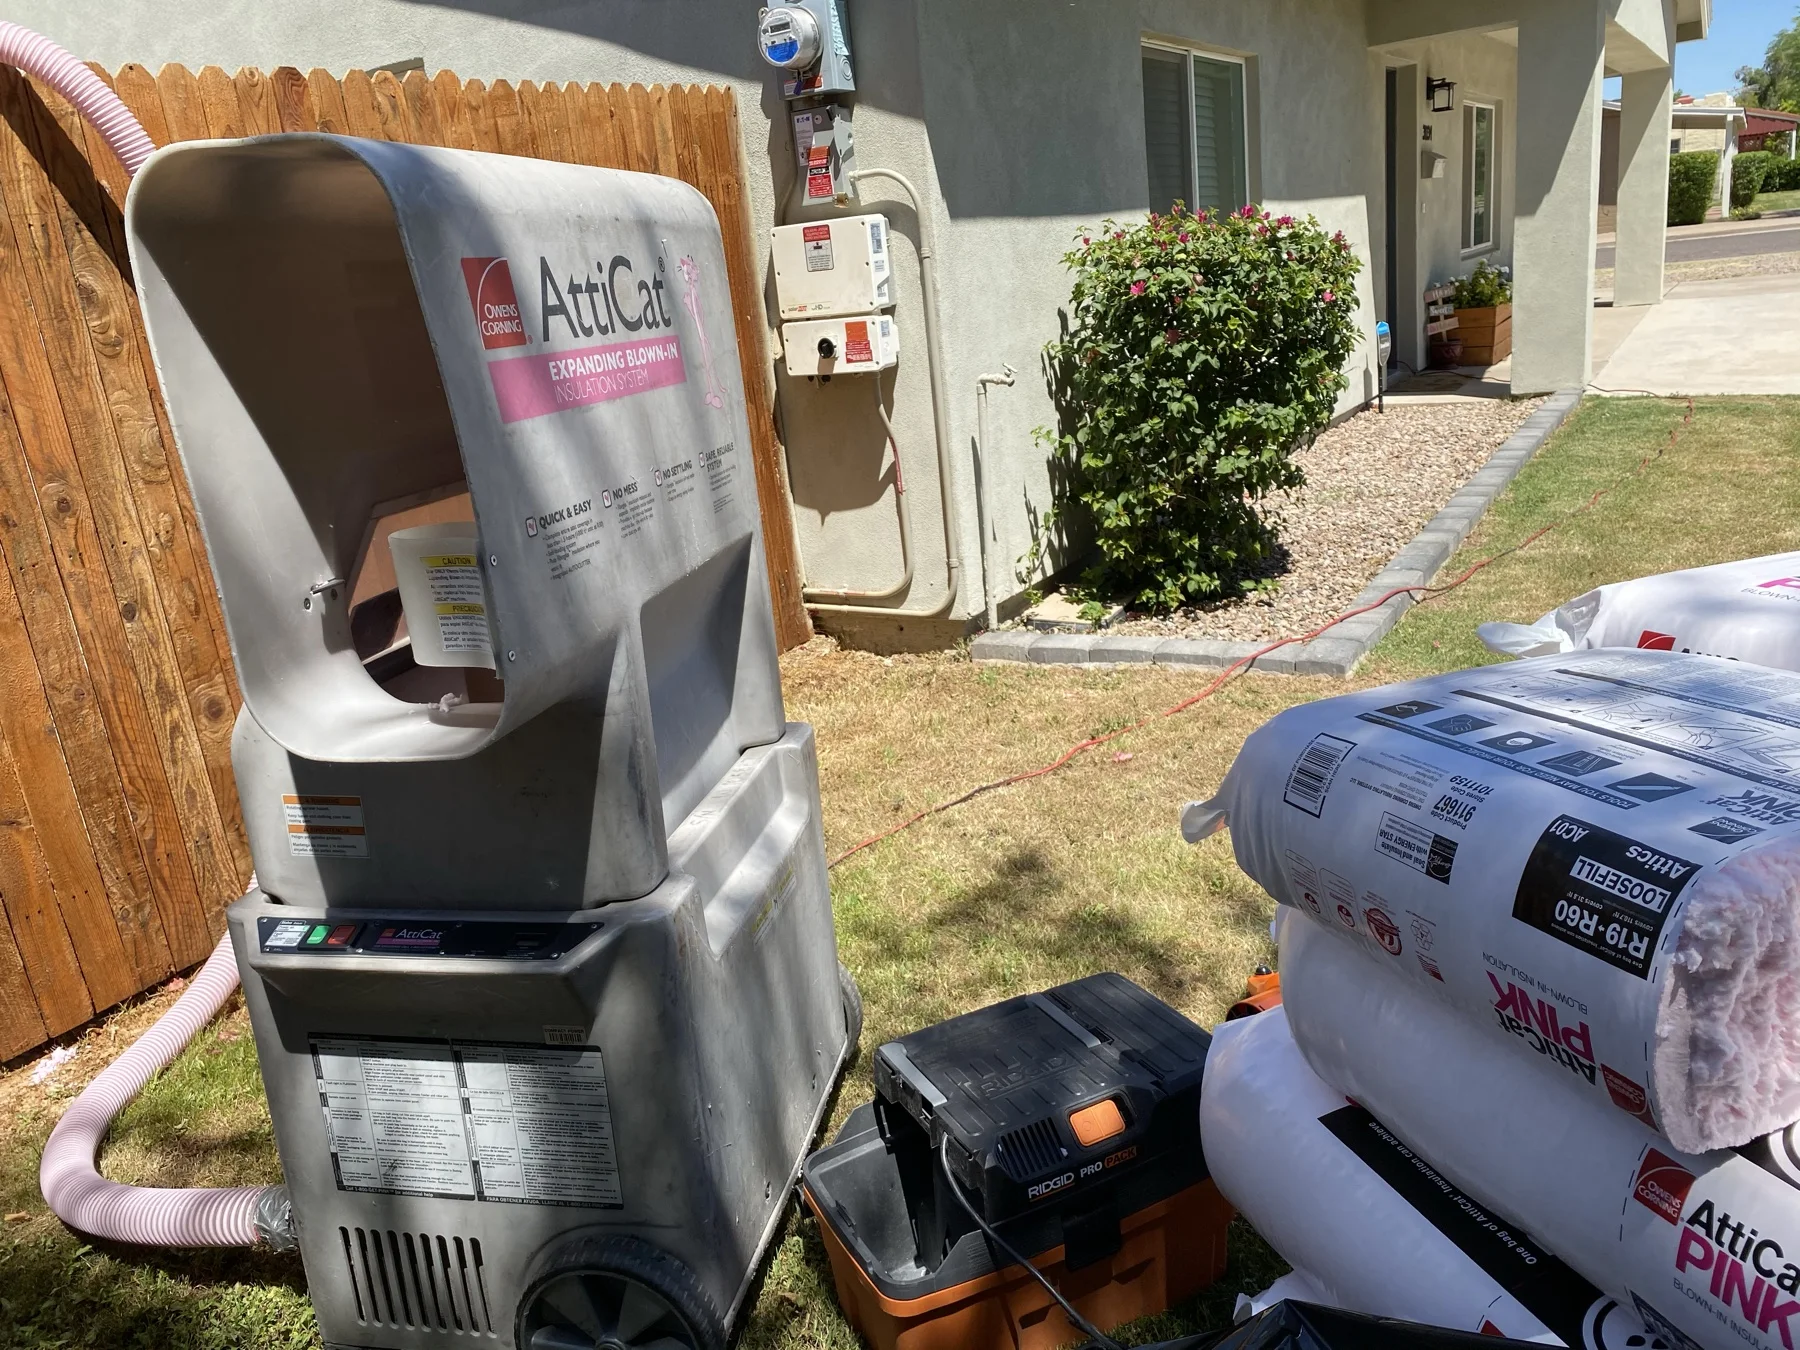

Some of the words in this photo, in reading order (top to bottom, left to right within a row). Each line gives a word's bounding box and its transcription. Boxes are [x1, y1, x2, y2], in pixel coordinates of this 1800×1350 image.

[484, 303, 518, 319] OWENS
[481, 320, 522, 336] CORNING
[548, 349, 624, 381] EXPANDING
[626, 343, 679, 366] BLOWN-IN
[553, 376, 618, 404] INSULATION
[617, 368, 649, 394] SYSTEM
[707, 458, 723, 472] SYSTEM
[662, 469, 671, 480] NO
[612, 487, 623, 501] NO
[623, 482, 638, 496] MESS
[539, 508, 566, 530] QUICK
[567, 508, 573, 518] &
[573, 499, 592, 517] EASY
[442, 557, 471, 565] CAUTION
[1450, 775, 1494, 796] 1011159
[1450, 785, 1466, 797] Code
[1557, 776, 1579, 791] MAY
[1578, 785, 1599, 798] YOU
[1466, 791, 1486, 803] Stores
[1599, 792, 1632, 807] TOOLS
[1430, 810, 1445, 821] Code
[1434, 794, 1477, 823] 911667
[1445, 815, 1467, 830] Product
[1549, 820, 1590, 843] AC01
[1379, 829, 1394, 844] STAR
[1393, 836, 1416, 853] ENERGY
[1381, 841, 1402, 858] Insulate
[1402, 851, 1413, 862] and
[1416, 845, 1428, 856] with
[1413, 857, 1426, 869] Seal
[1625, 845, 1691, 879] Attics
[1574, 858, 1668, 910] LOOSEFILL
[1584, 897, 1603, 910] covers
[1554, 899, 1599, 937] R60
[1634, 918, 1654, 932] covers
[1605, 922, 1650, 960] R19
[1482, 951, 1534, 987] INSULATION
[1622, 955, 1632, 965] bag
[1632, 960, 1643, 969] One
[1537, 981, 1588, 1016] BLOWN-IN
[1486, 970, 1595, 1064] PINK
[1368, 1120, 1399, 1148] achieve
[1397, 1146, 1414, 1162] can
[1027, 1172, 1075, 1199] RIDGID
[1080, 1161, 1103, 1178] PRO
[1105, 1149, 1136, 1168] PACK
[1411, 1157, 1453, 1194] Insulation
[1637, 1185, 1678, 1219] CORNING
[1647, 1180, 1682, 1208] OWENS
[1483, 1217, 1498, 1232] of
[1497, 1230, 1518, 1250] bag
[1686, 1199, 1800, 1297] AttiCa
[1516, 1246, 1537, 1266] One
[1675, 1225, 1800, 1350] PINK
[1673, 1277, 1728, 1325] BLOWN-IN
[1730, 1319, 1774, 1350] INSUL
